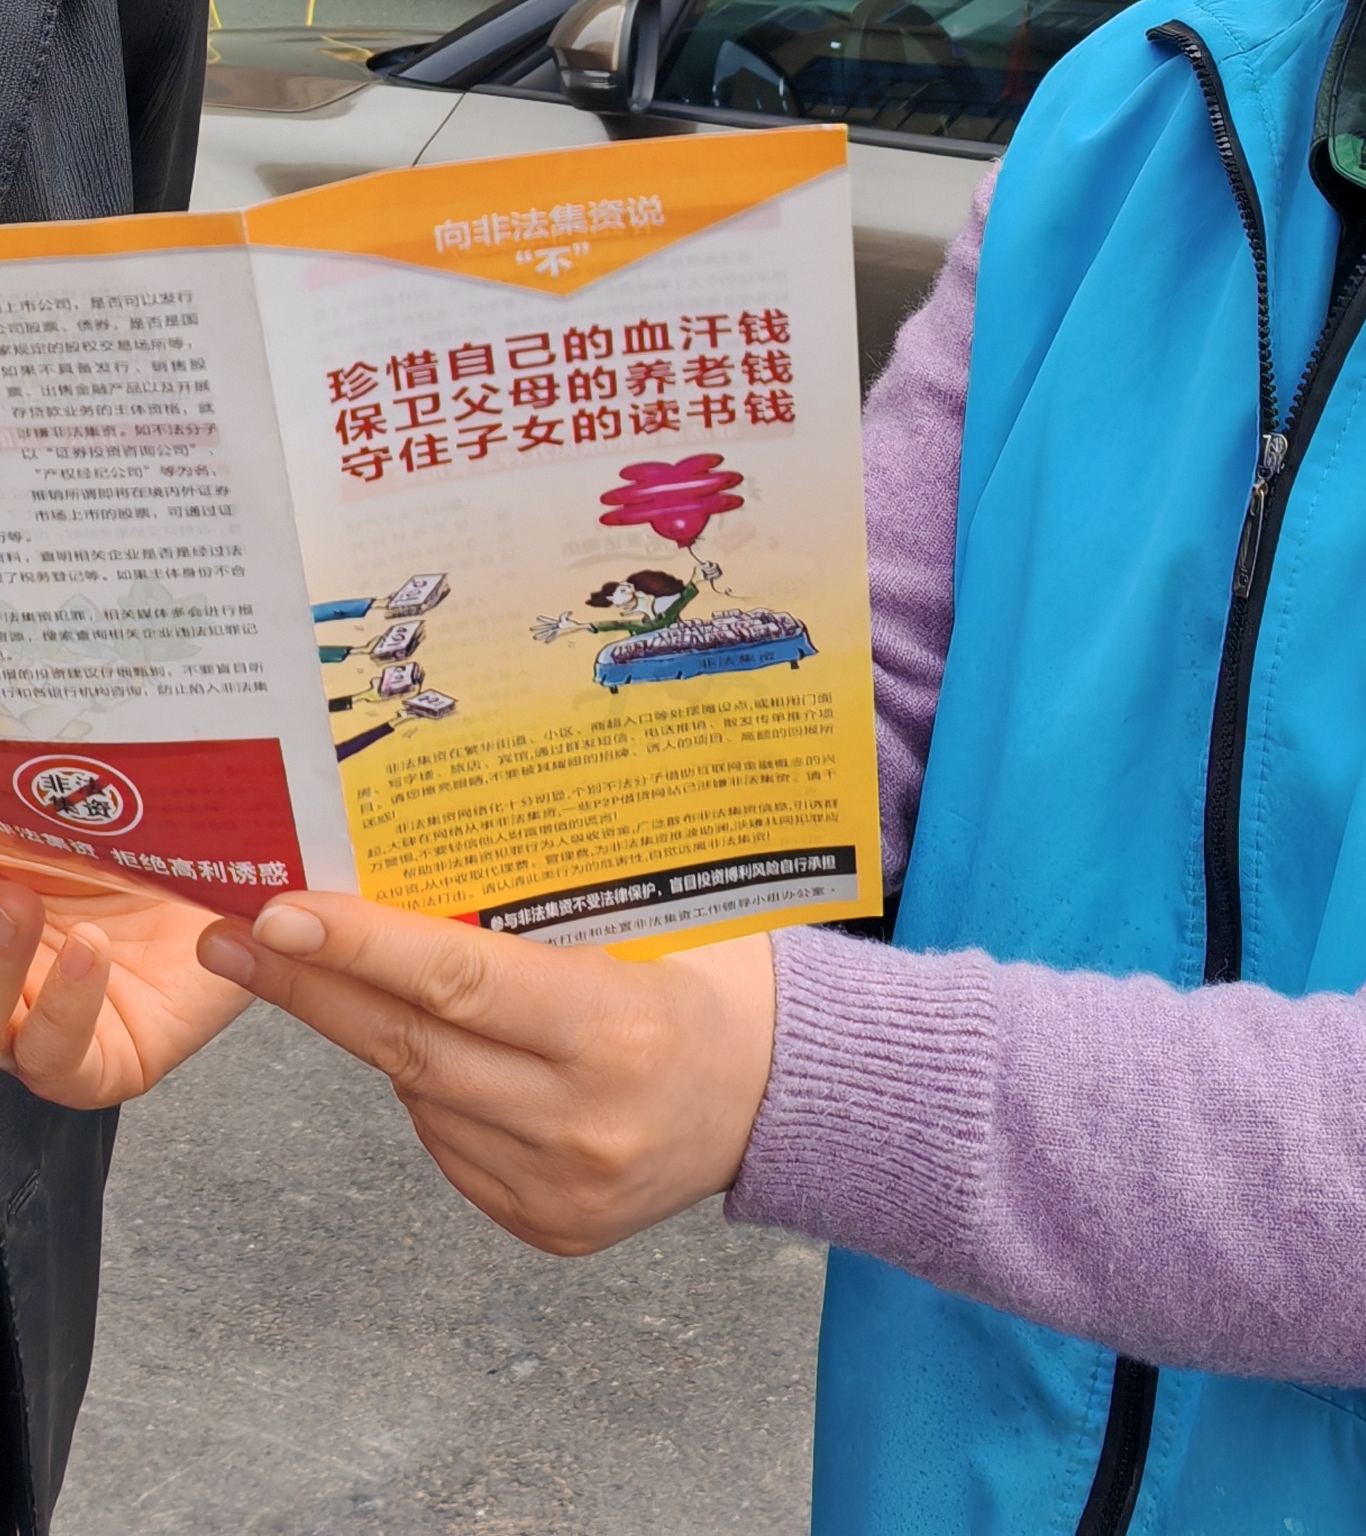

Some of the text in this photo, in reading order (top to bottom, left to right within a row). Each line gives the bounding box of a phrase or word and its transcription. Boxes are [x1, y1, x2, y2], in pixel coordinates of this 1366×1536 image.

[434, 194, 666, 254] 向非法集资说
[515, 241, 591, 278] “不”
[326, 308, 791, 404] 珍惜自己的血汗钱
[335, 350, 795, 446] 保卫父母的养老钱
[340, 389, 796, 482] 守住子女的读书钱
[109, 847, 291, 889] 拒绝高利诱惑
